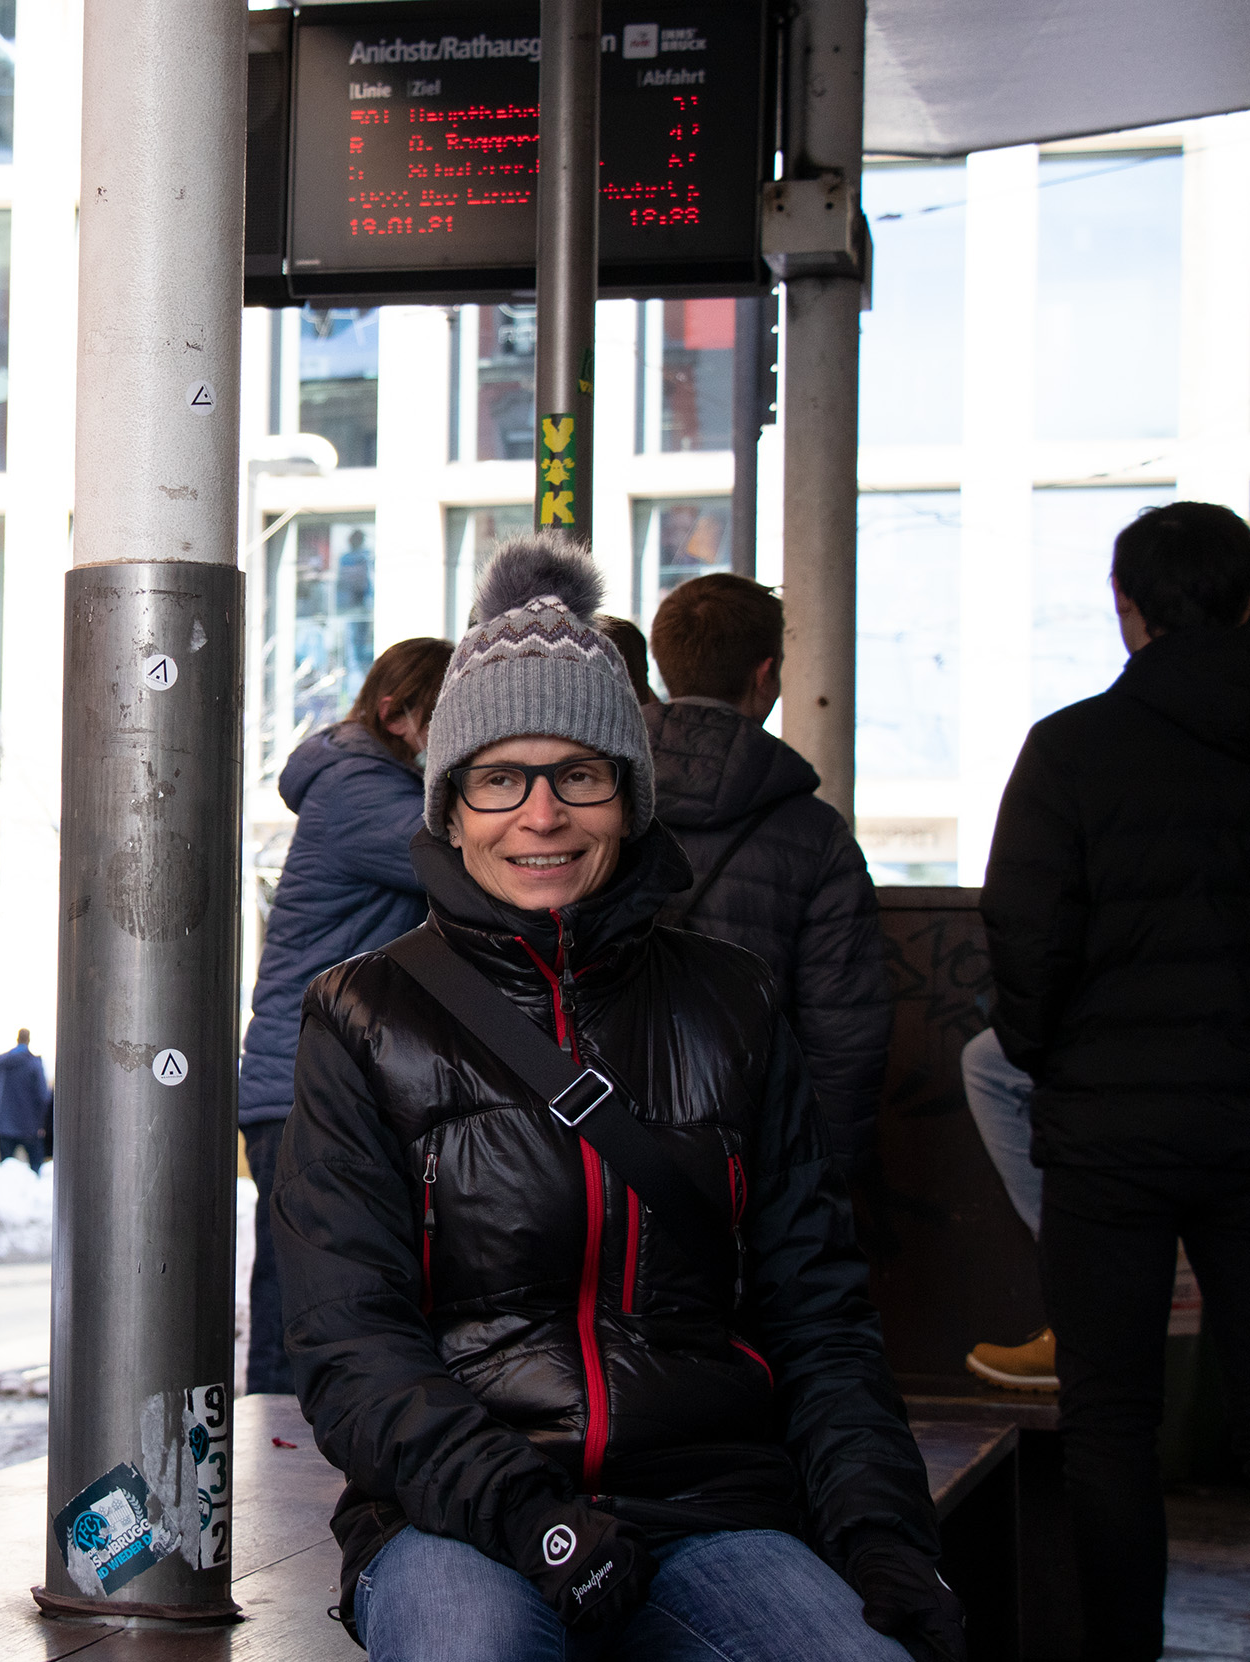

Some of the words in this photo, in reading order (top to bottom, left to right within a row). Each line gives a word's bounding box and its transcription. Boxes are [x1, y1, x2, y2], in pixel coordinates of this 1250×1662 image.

[354, 81, 392, 99] Linie
[411, 78, 441, 97] Ziel
[643, 67, 705, 87] Abfahrt
[106, 1540, 145, 1571] WIEDER
[141, 1529, 153, 1546] D
[571, 1560, 614, 1604] windproof
